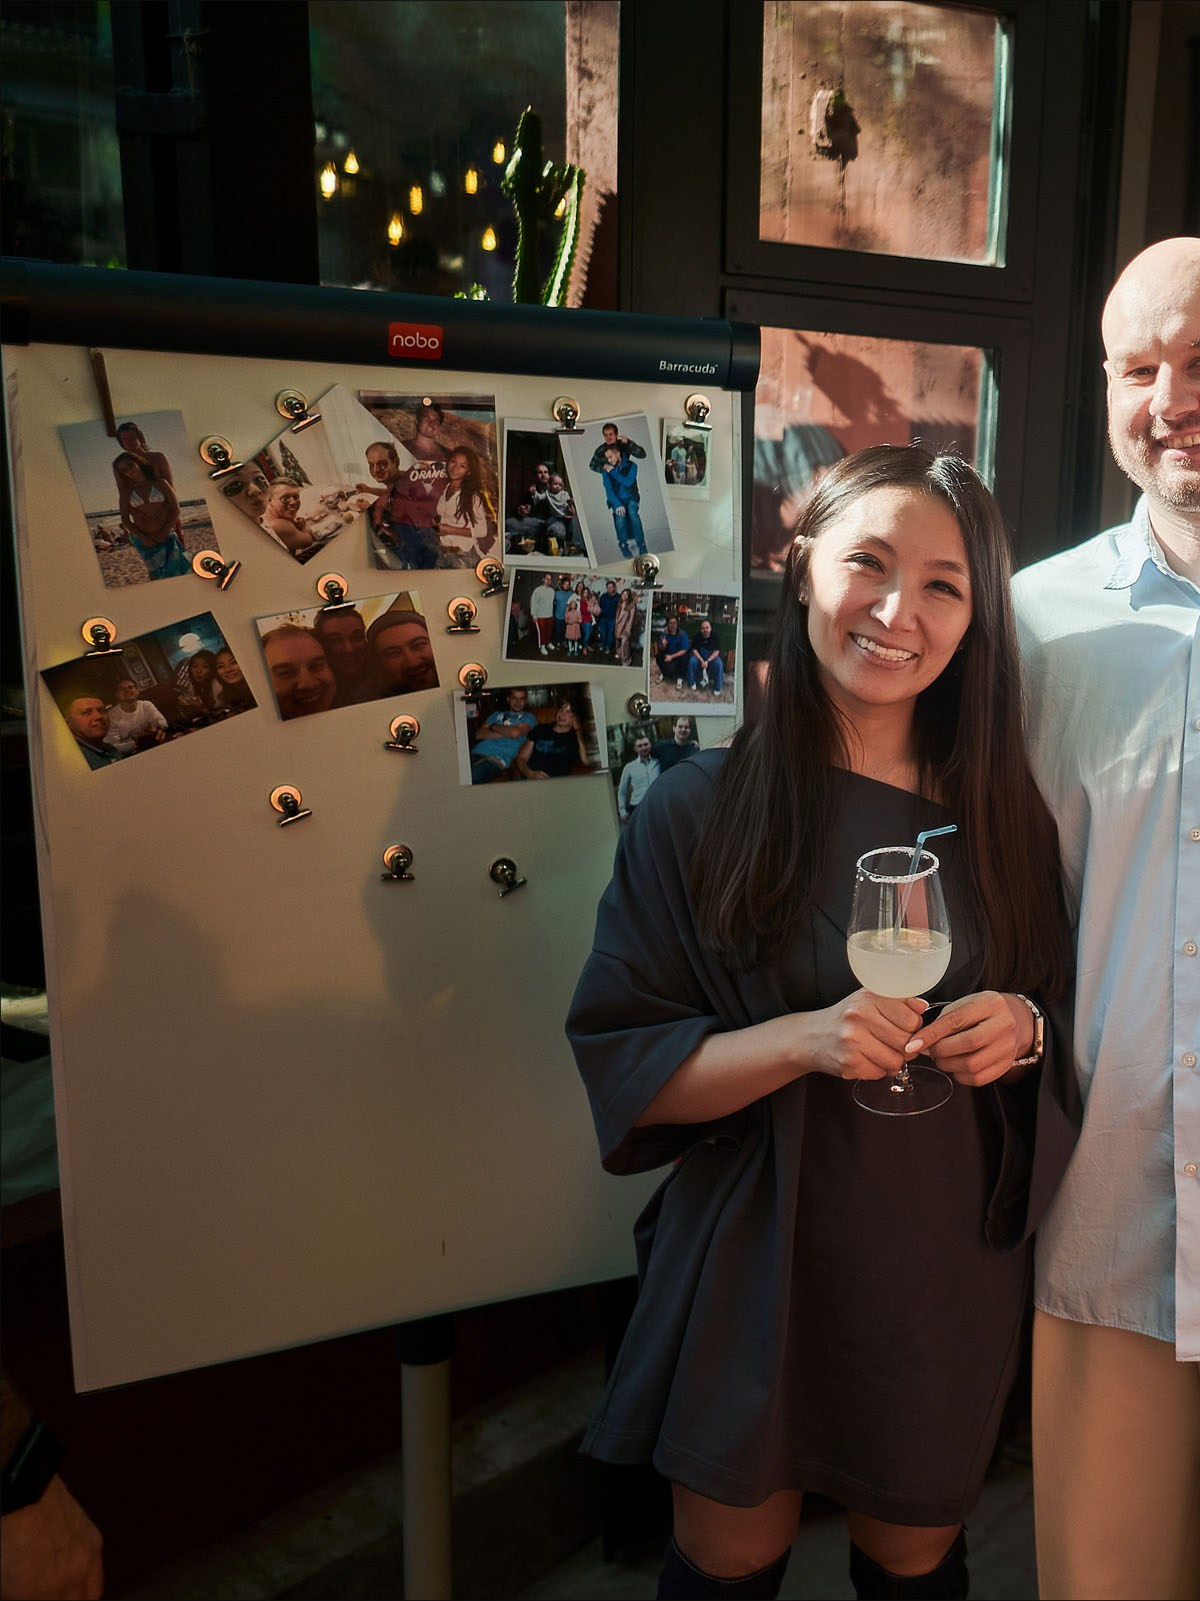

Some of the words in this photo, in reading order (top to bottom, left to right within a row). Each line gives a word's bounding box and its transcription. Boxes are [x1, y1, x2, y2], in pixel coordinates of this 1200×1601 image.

[392, 331, 440, 349] nobo
[659, 360, 716, 375] Barracuda
[409, 468, 448, 482] ORANG
